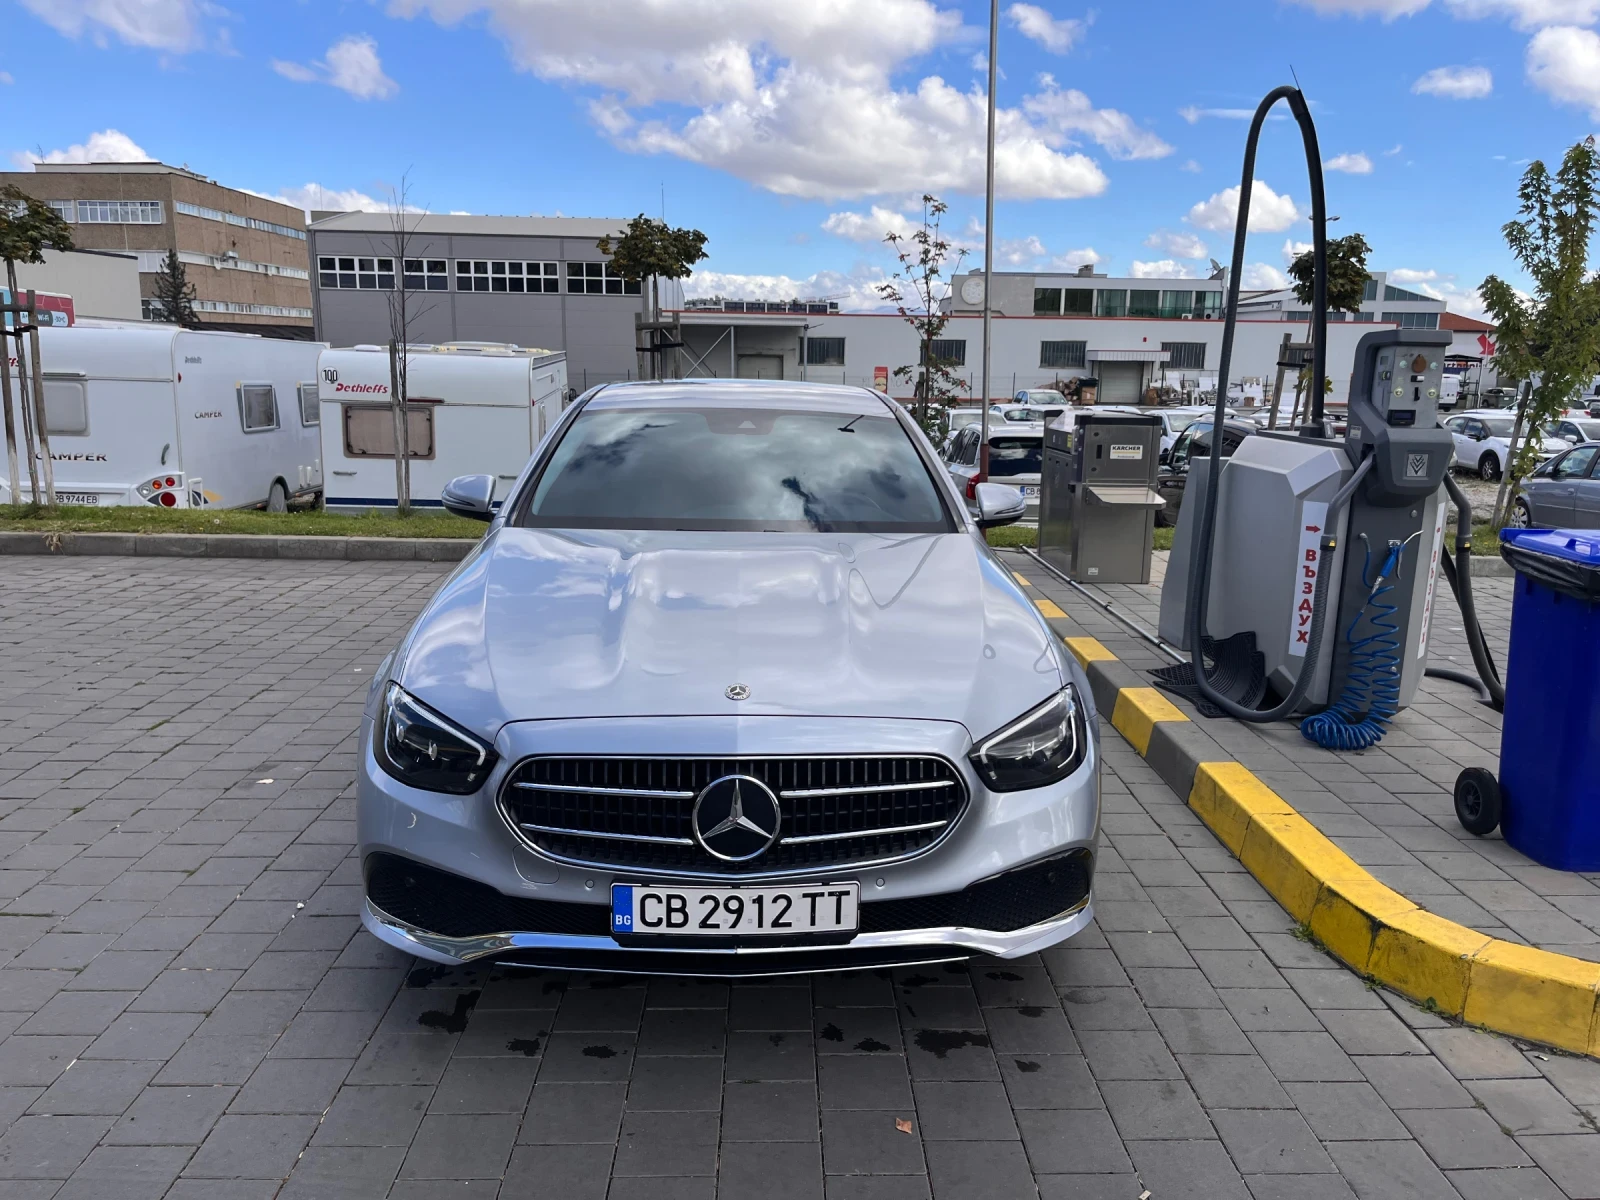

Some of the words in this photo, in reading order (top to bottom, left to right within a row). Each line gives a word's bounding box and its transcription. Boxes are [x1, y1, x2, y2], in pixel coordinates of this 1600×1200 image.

[323, 369, 338, 382] 100
[335, 382, 389, 394] Dethleffs
[194, 410, 222, 419] CAMPER
[35, 451, 107, 462] CAMPER
[65, 494, 85, 504] 9744
[86, 495, 98, 504] EB
[1296, 548, 1316, 644] ВЪЗДУХ
[639, 892, 689, 929] CB
[698, 893, 793, 929] 2912
[801, 889, 851, 927] TT
[615, 914, 631, 926] BG
